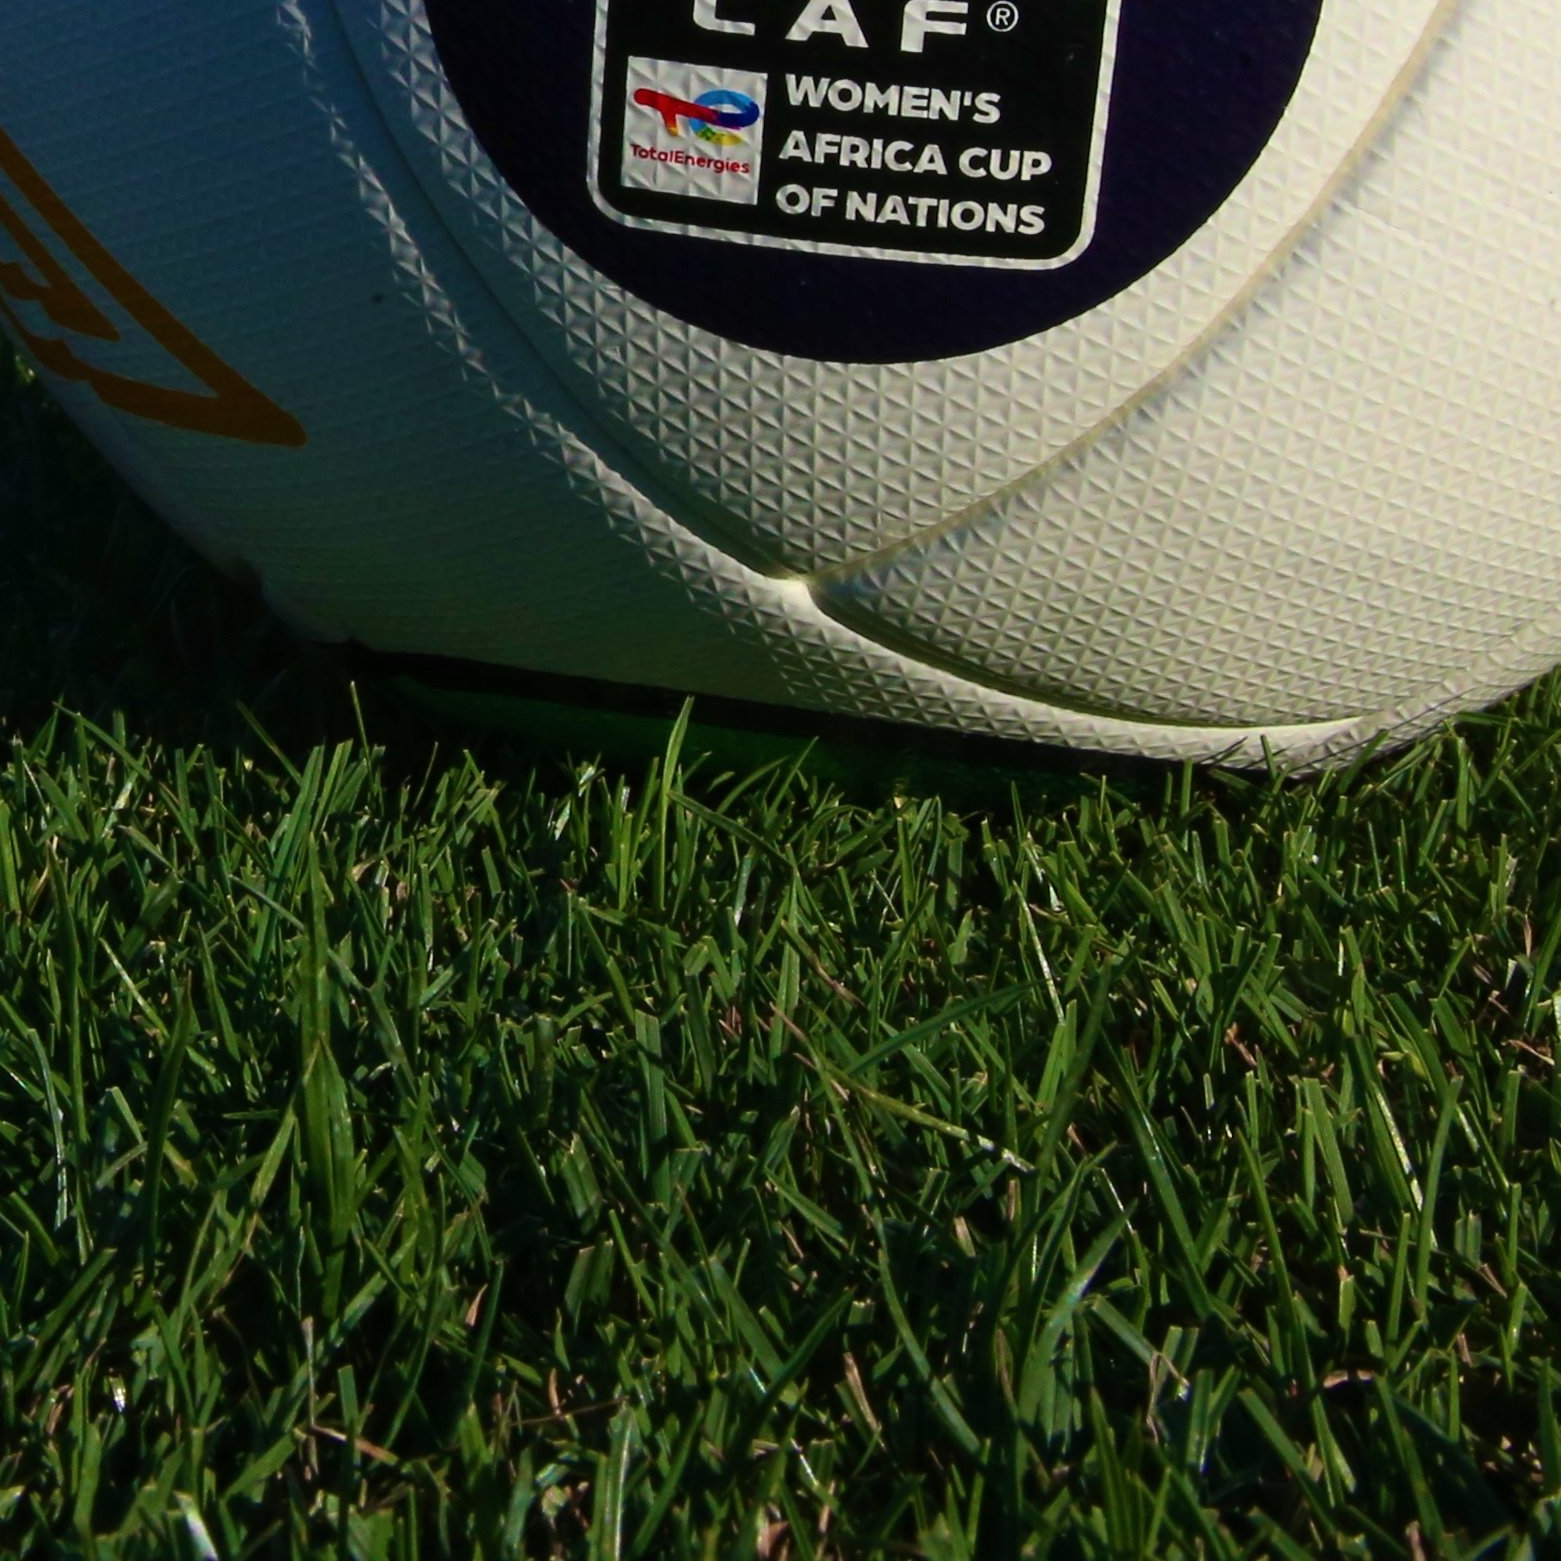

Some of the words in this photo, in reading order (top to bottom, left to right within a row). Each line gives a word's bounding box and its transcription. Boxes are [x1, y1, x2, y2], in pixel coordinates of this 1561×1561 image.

[785, 72, 1001, 124] WOMEN'S
[630, 143, 751, 174] TotalEnergies
[779, 130, 948, 175] AFRICA
[958, 147, 1053, 181] CUP
[775, 183, 839, 217] OF
[845, 191, 1046, 236] NATIONS
